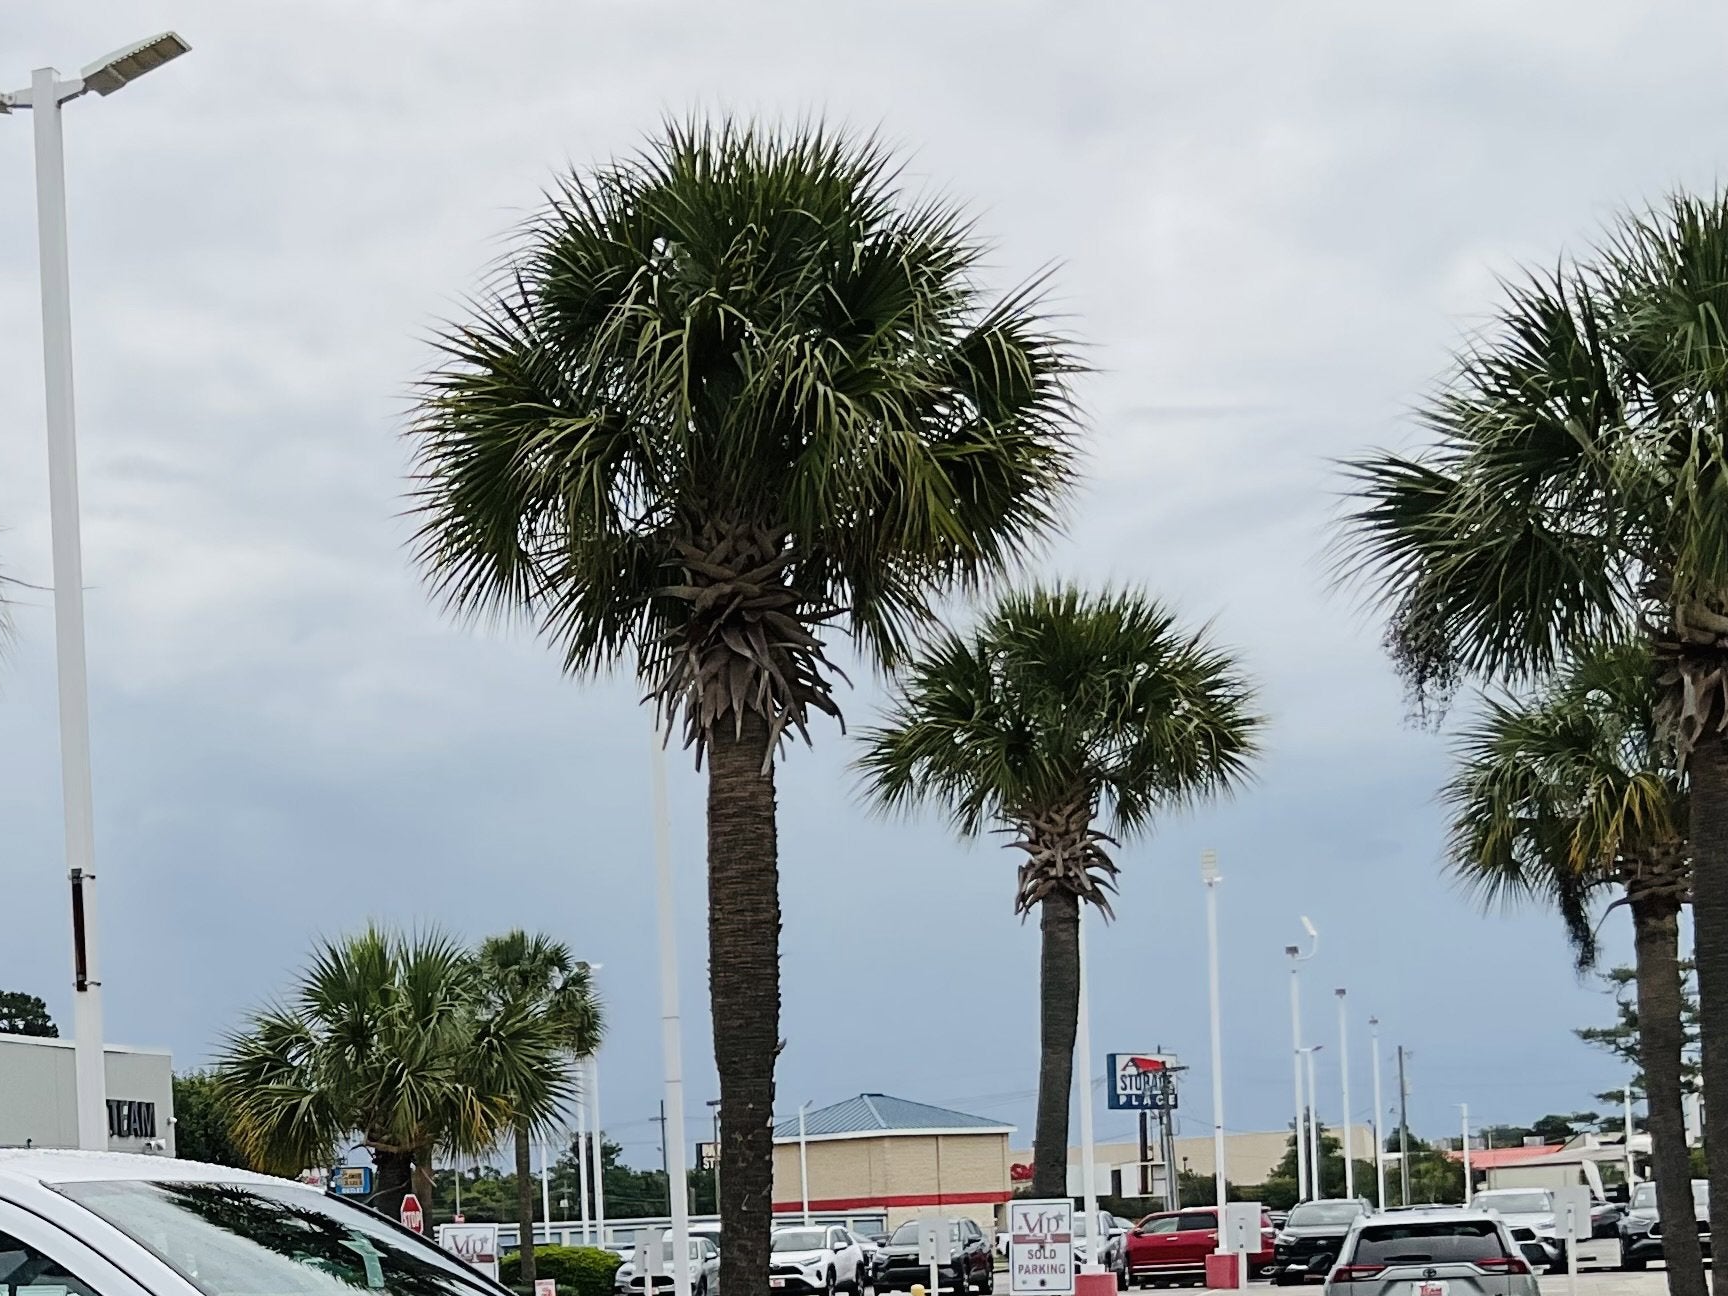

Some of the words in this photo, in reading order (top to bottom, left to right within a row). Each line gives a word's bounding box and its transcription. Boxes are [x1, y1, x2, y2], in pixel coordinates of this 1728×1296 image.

[1119, 1094, 1176, 1106] PLACE
[105, 1099, 156, 1137] TEAM
[1027, 1249, 1057, 1260] SOLD
[1018, 1264, 1066, 1275] PARKING
